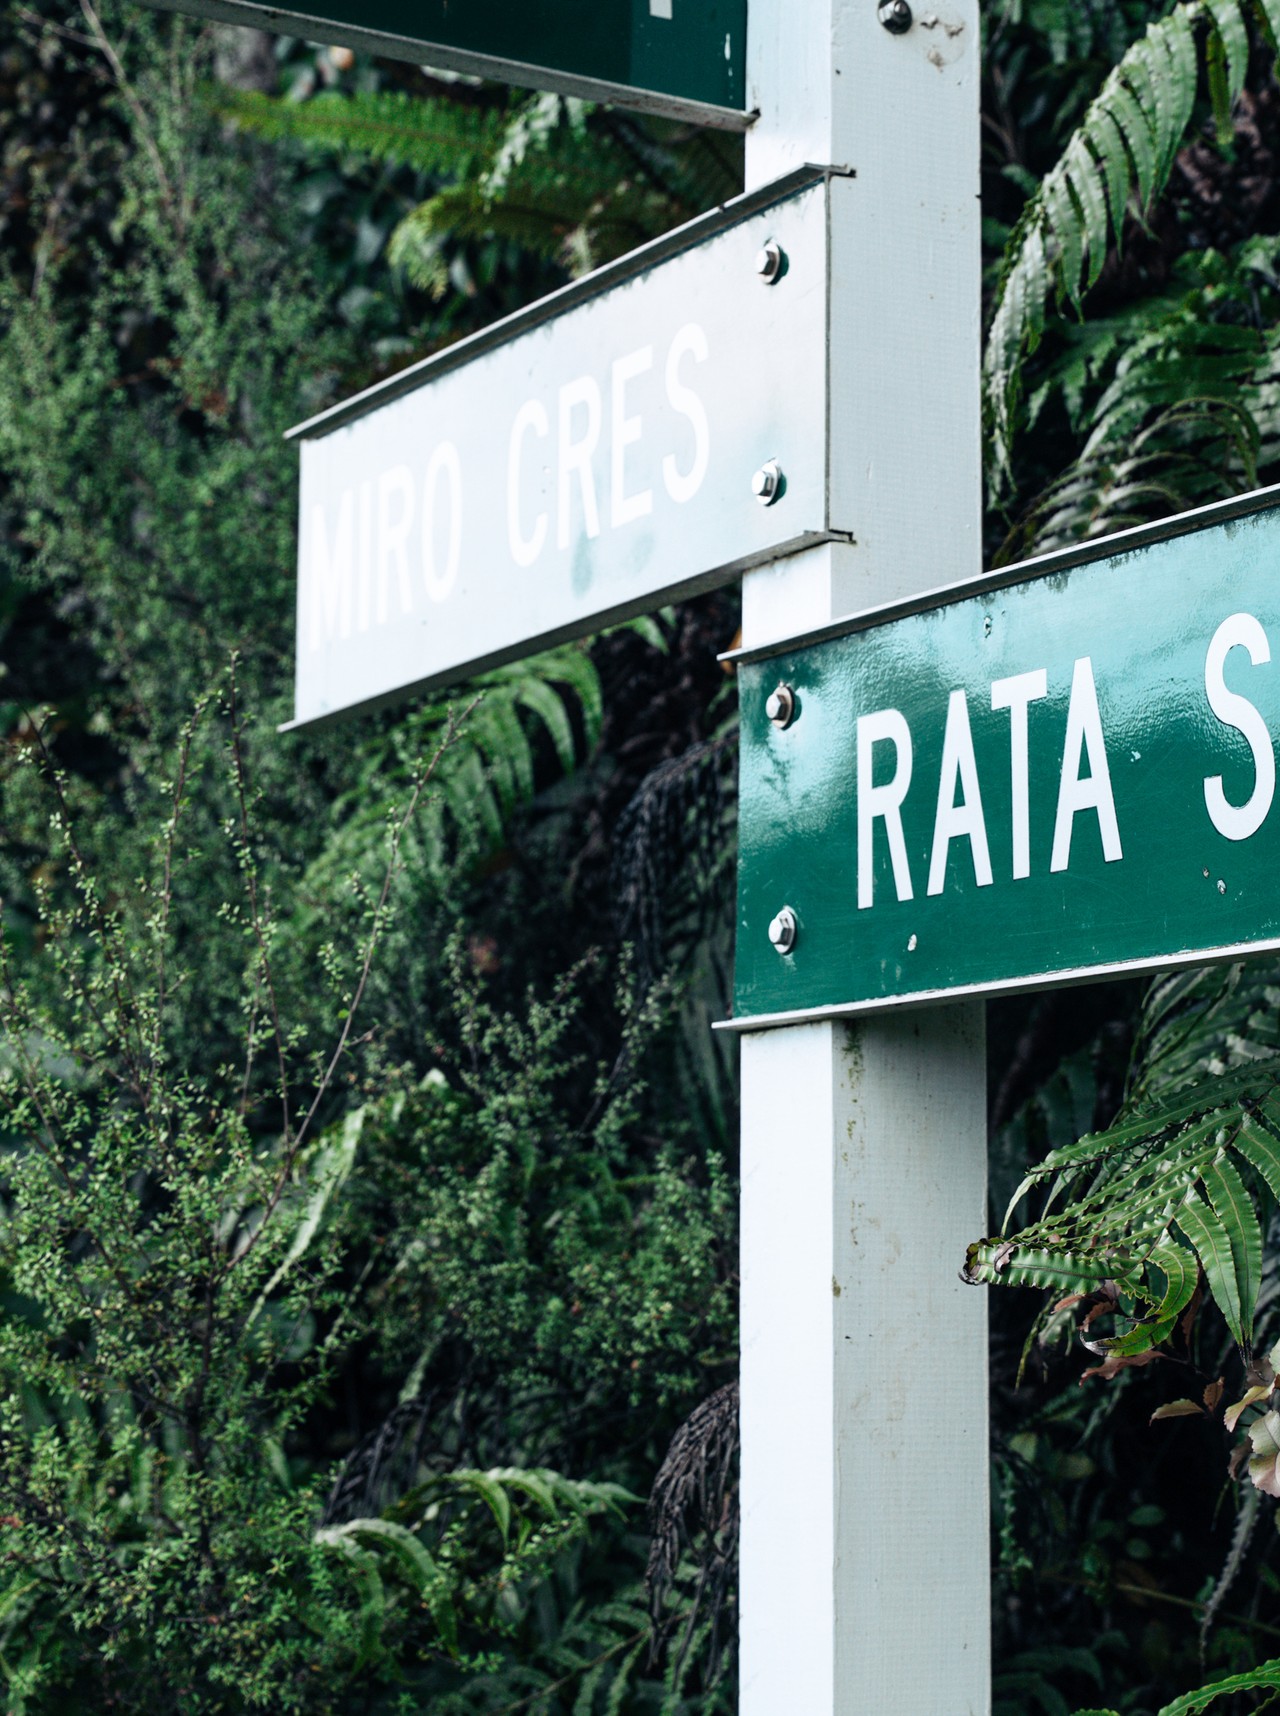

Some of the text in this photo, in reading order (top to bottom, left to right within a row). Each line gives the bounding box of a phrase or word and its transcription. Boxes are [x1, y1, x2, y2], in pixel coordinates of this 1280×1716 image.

[309, 322, 710, 652] MIRO CRES
[857, 657, 1123, 909] RATA
